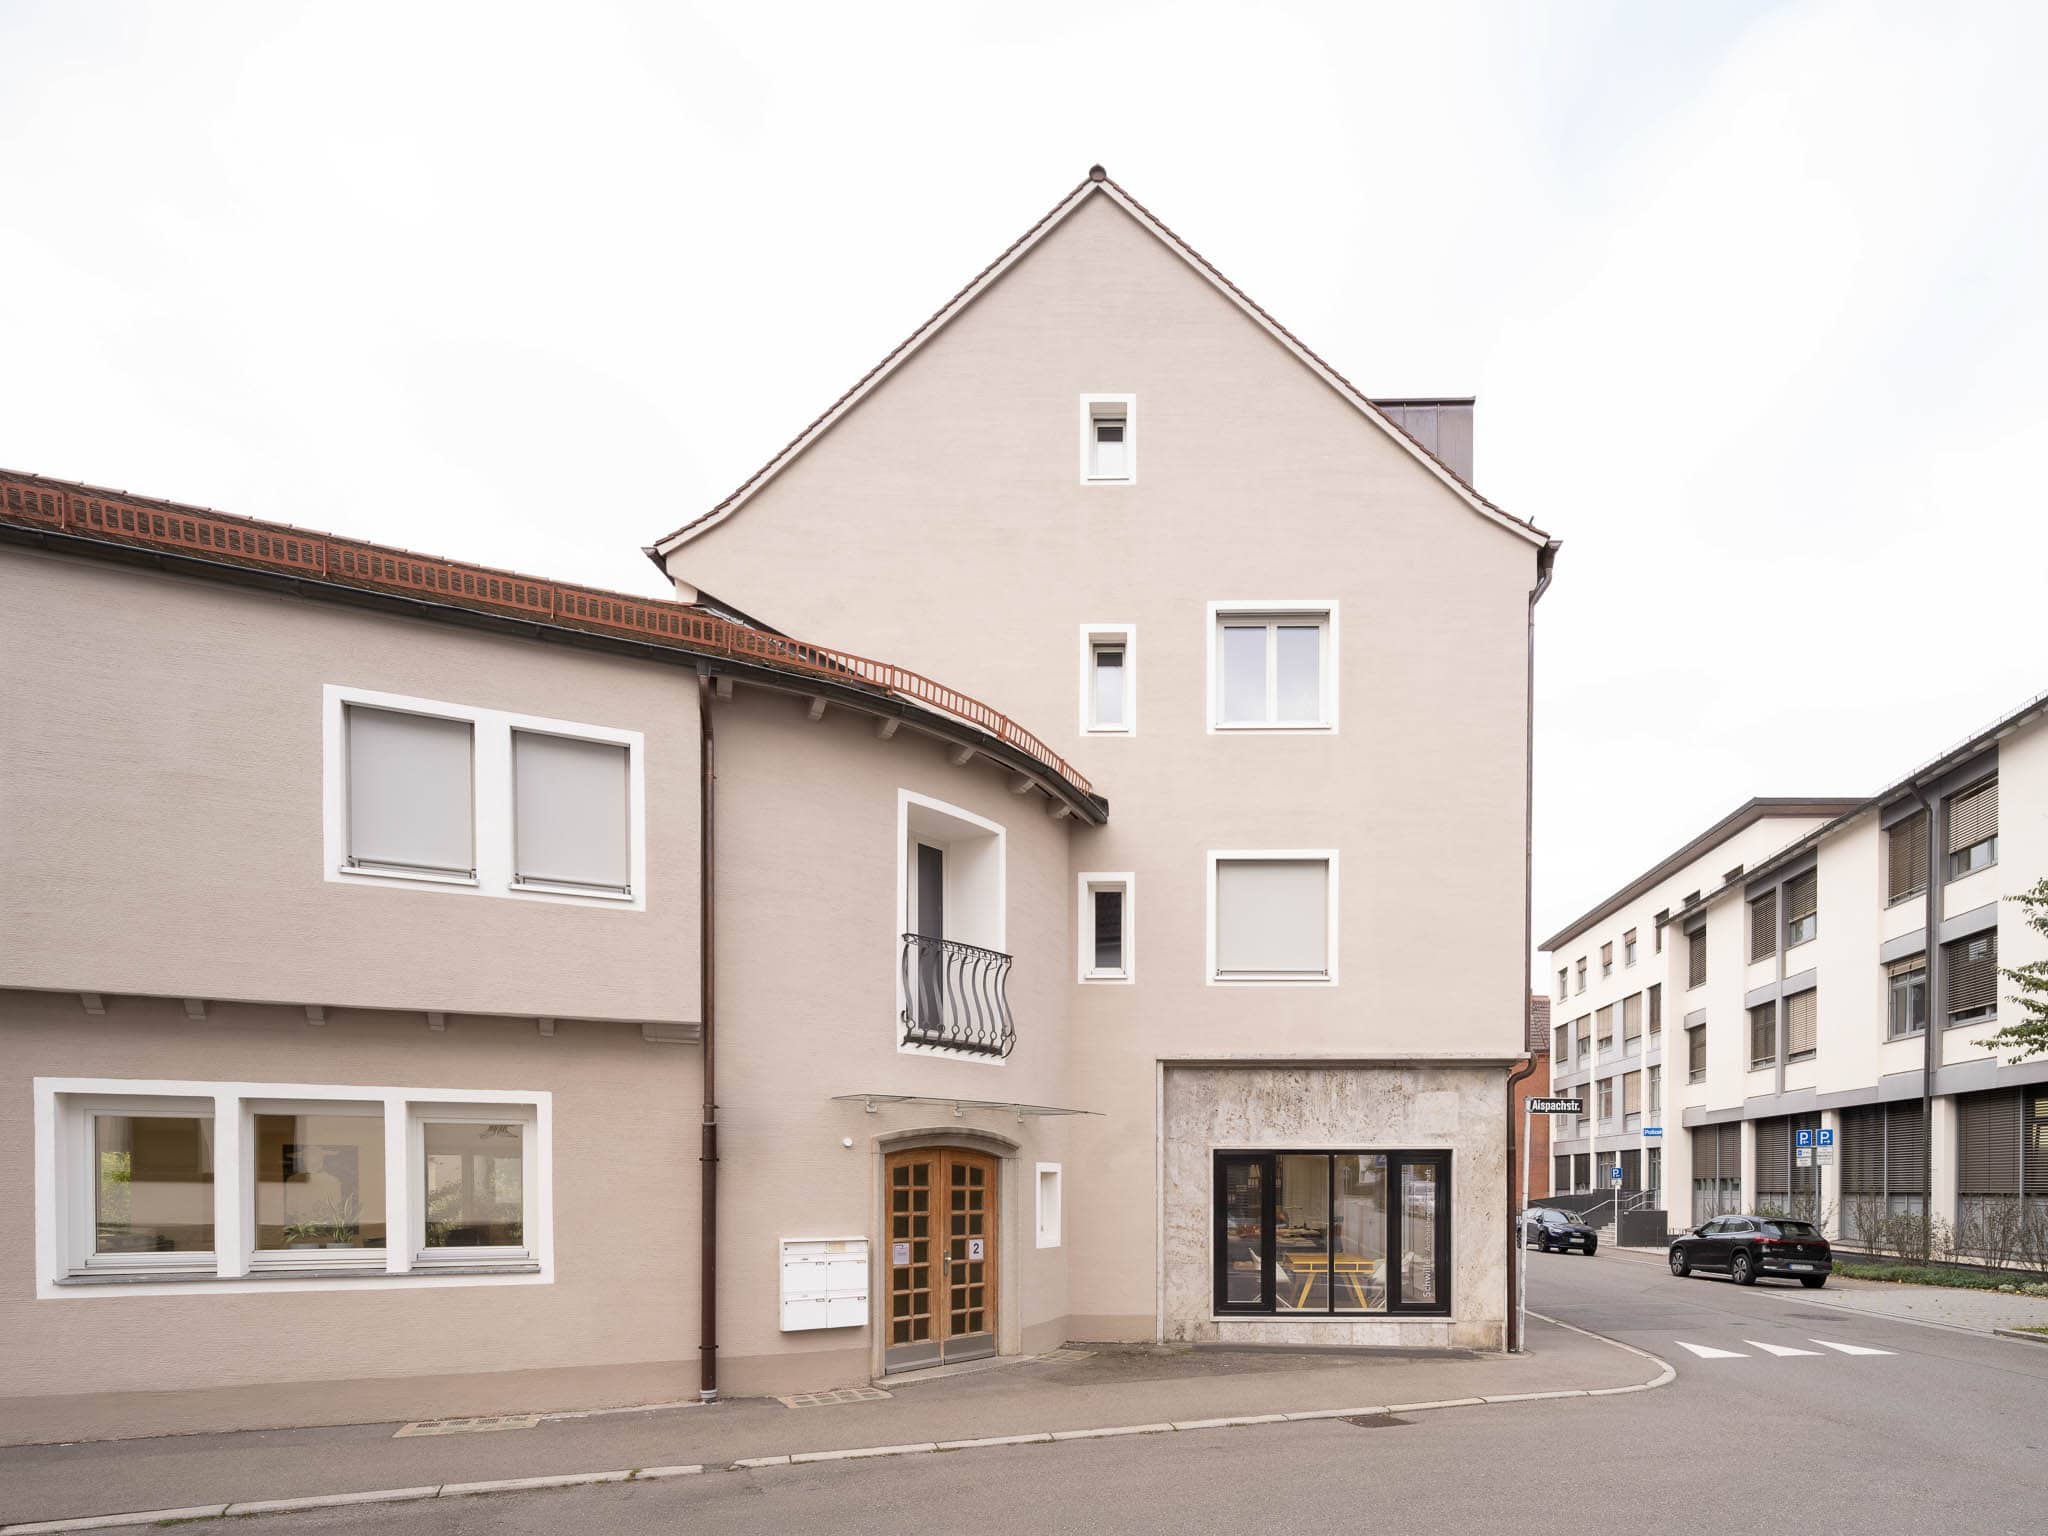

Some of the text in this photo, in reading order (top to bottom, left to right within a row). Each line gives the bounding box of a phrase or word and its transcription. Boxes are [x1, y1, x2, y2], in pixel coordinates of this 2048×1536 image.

[1532, 1099, 1580, 1113] Aispachstr.
[1799, 1132, 1809, 1145] P
[1820, 1131, 1830, 1144] P
[1612, 1168, 1619, 1178] P
[973, 1242, 980, 1254] 2
